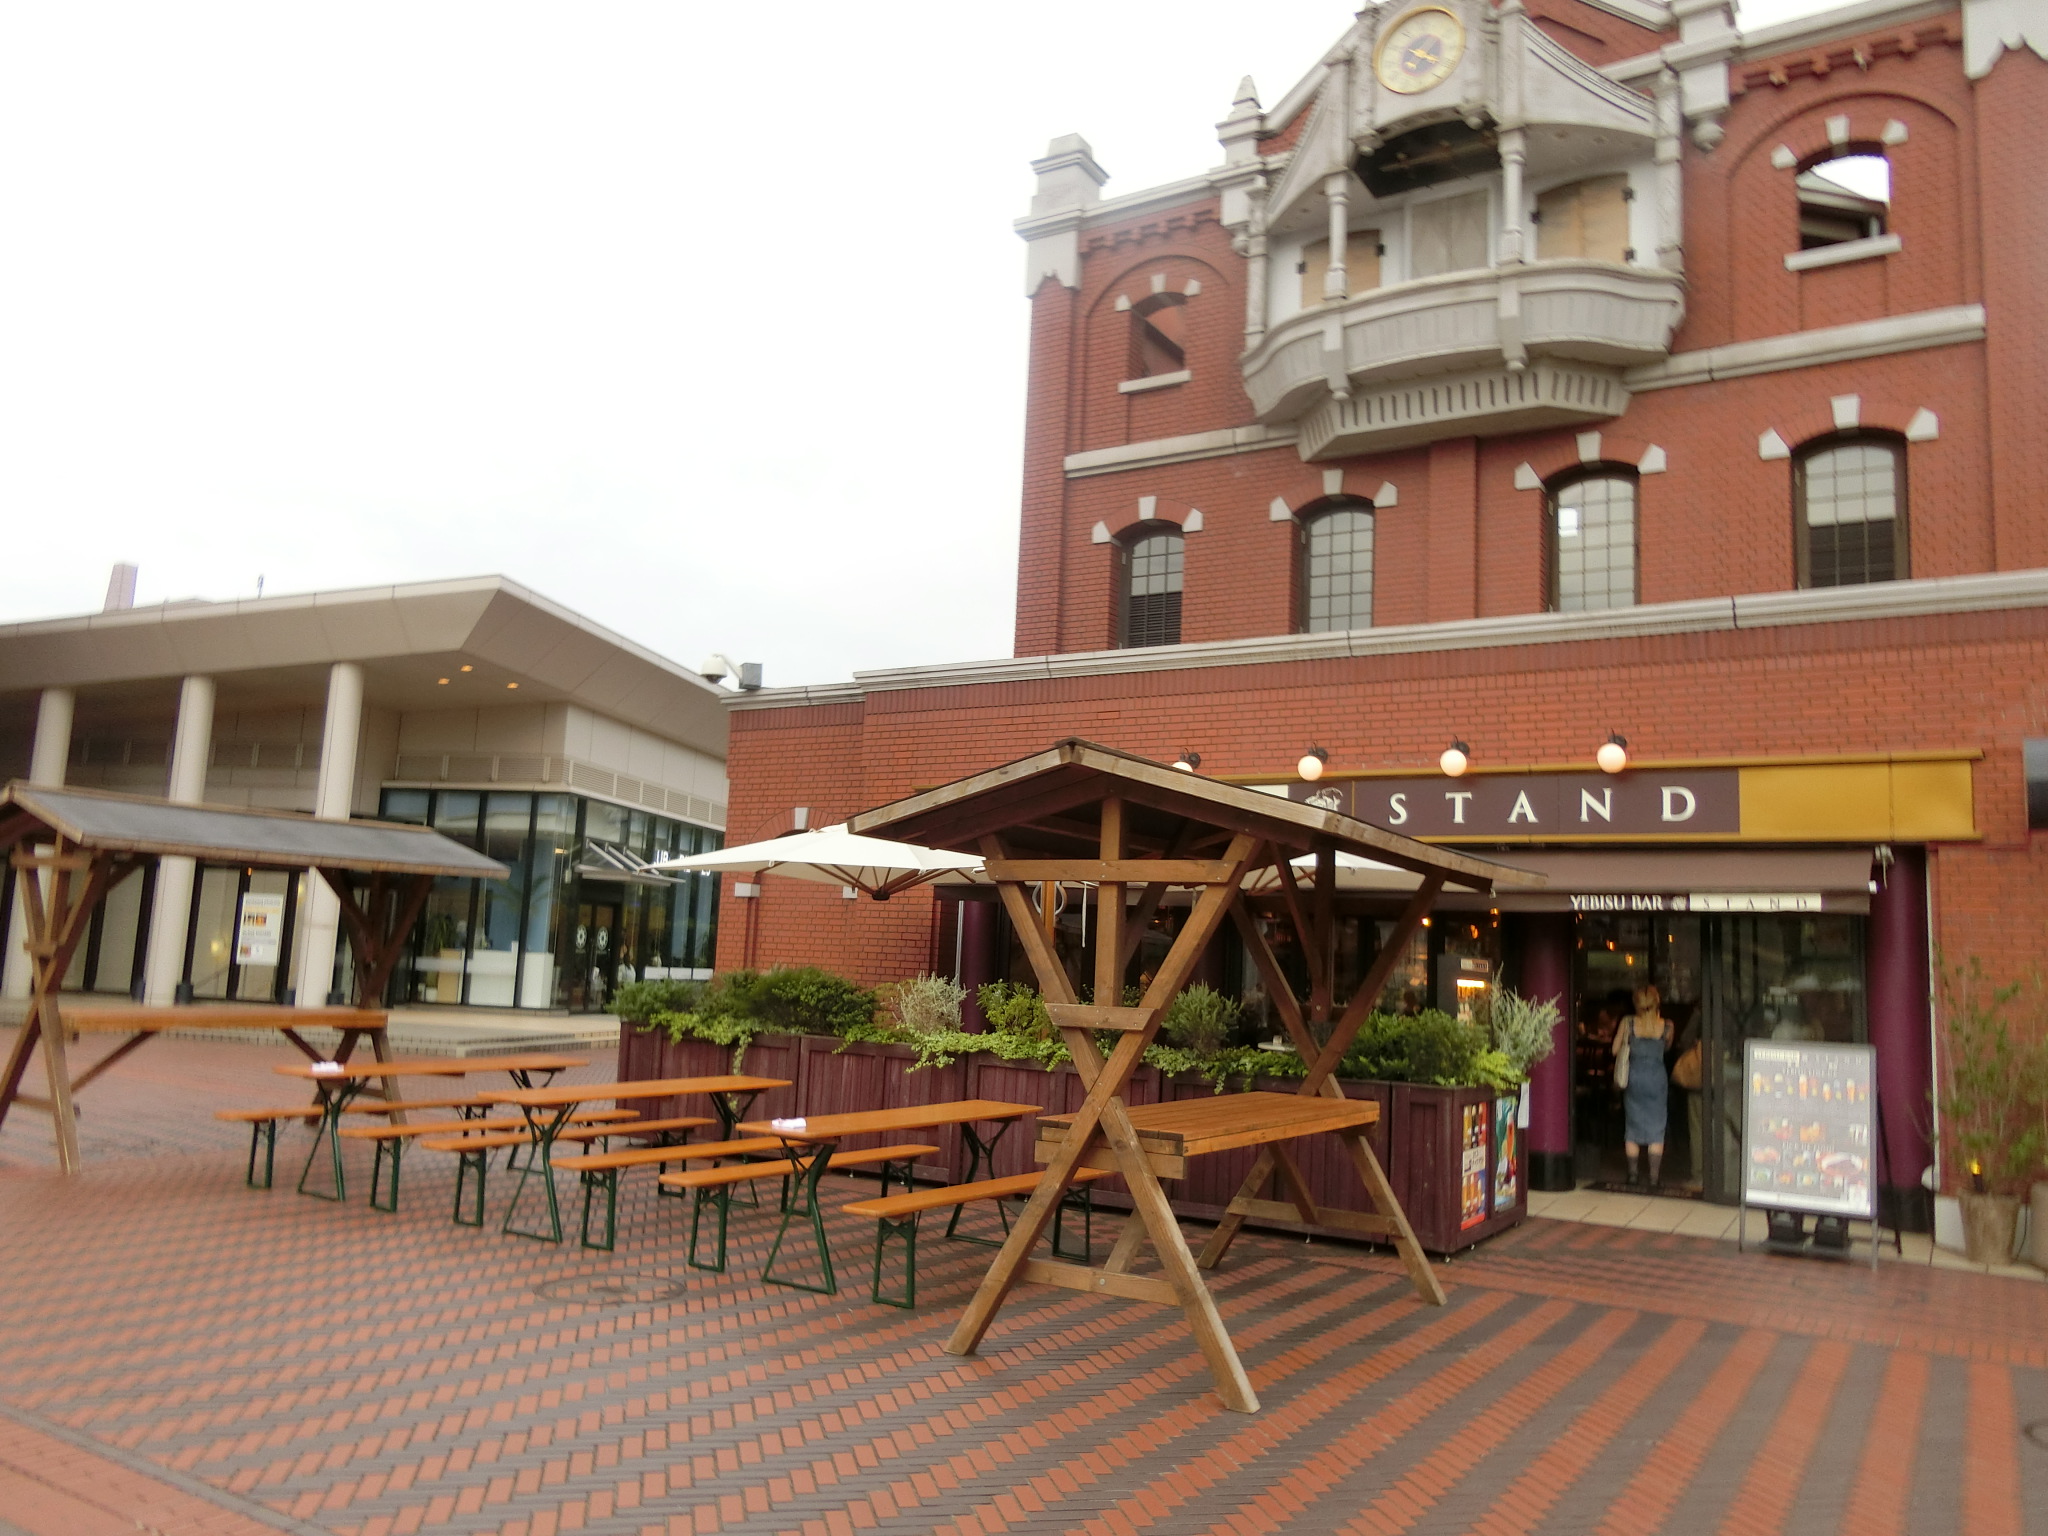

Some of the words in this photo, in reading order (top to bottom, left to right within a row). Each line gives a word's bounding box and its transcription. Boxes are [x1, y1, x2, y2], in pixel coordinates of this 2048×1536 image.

[1388, 786, 1697, 825] STAND
[1569, 894, 1626, 911] YEBISU
[1631, 894, 1663, 911] BAR
